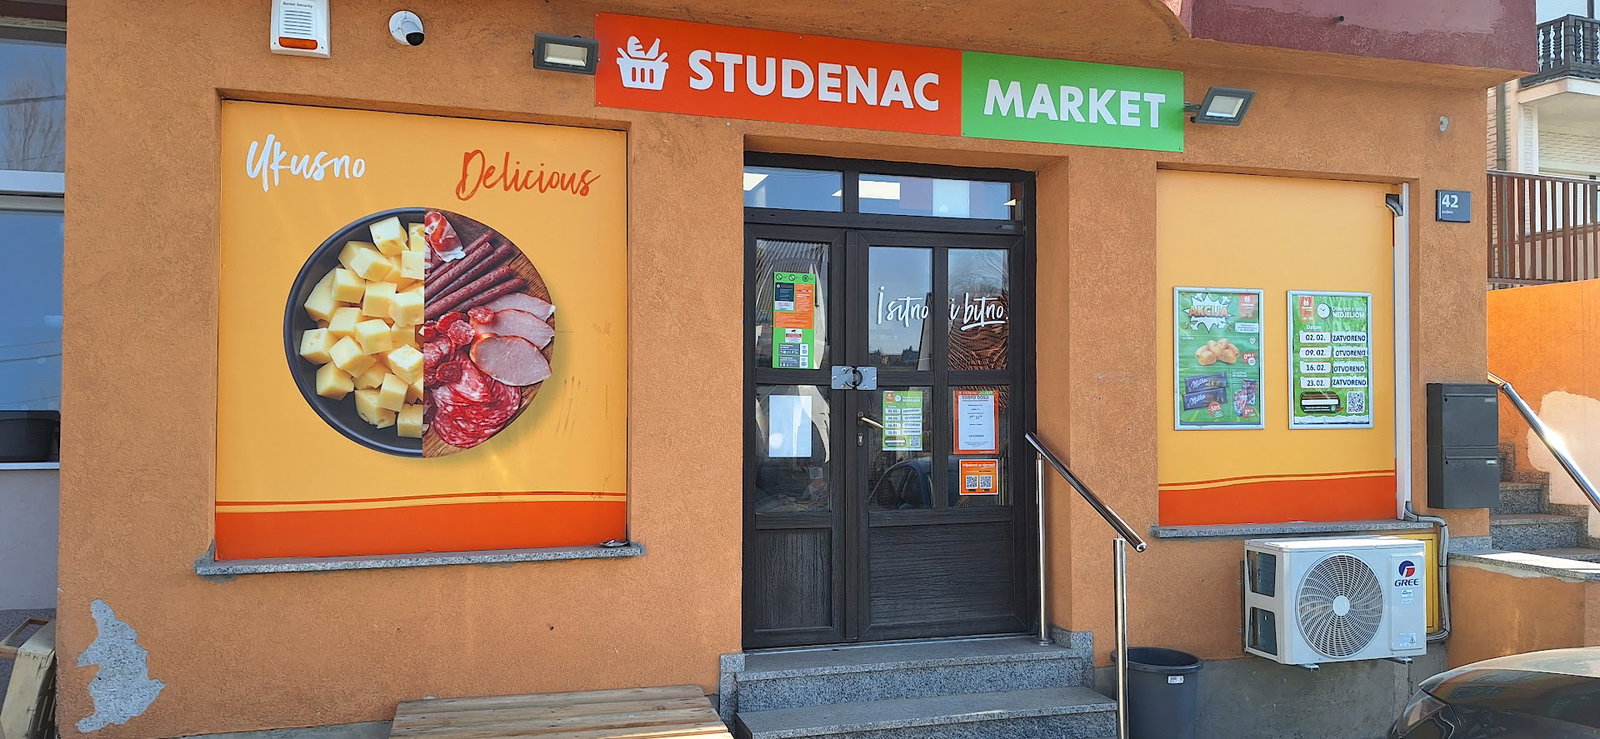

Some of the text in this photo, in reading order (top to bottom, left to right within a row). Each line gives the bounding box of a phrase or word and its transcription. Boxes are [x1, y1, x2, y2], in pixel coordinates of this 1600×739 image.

[688, 49, 939, 111] STUDENAC
[983, 78, 1166, 128] MARKET
[245, 133, 366, 192] Ukusno
[455, 149, 601, 201] Delicious
[1441, 194, 1459, 208] 42
[886, 296, 929, 328] sitno
[1188, 305, 1229, 317] AKCIJA
[1394, 579, 1420, 588] GREE
